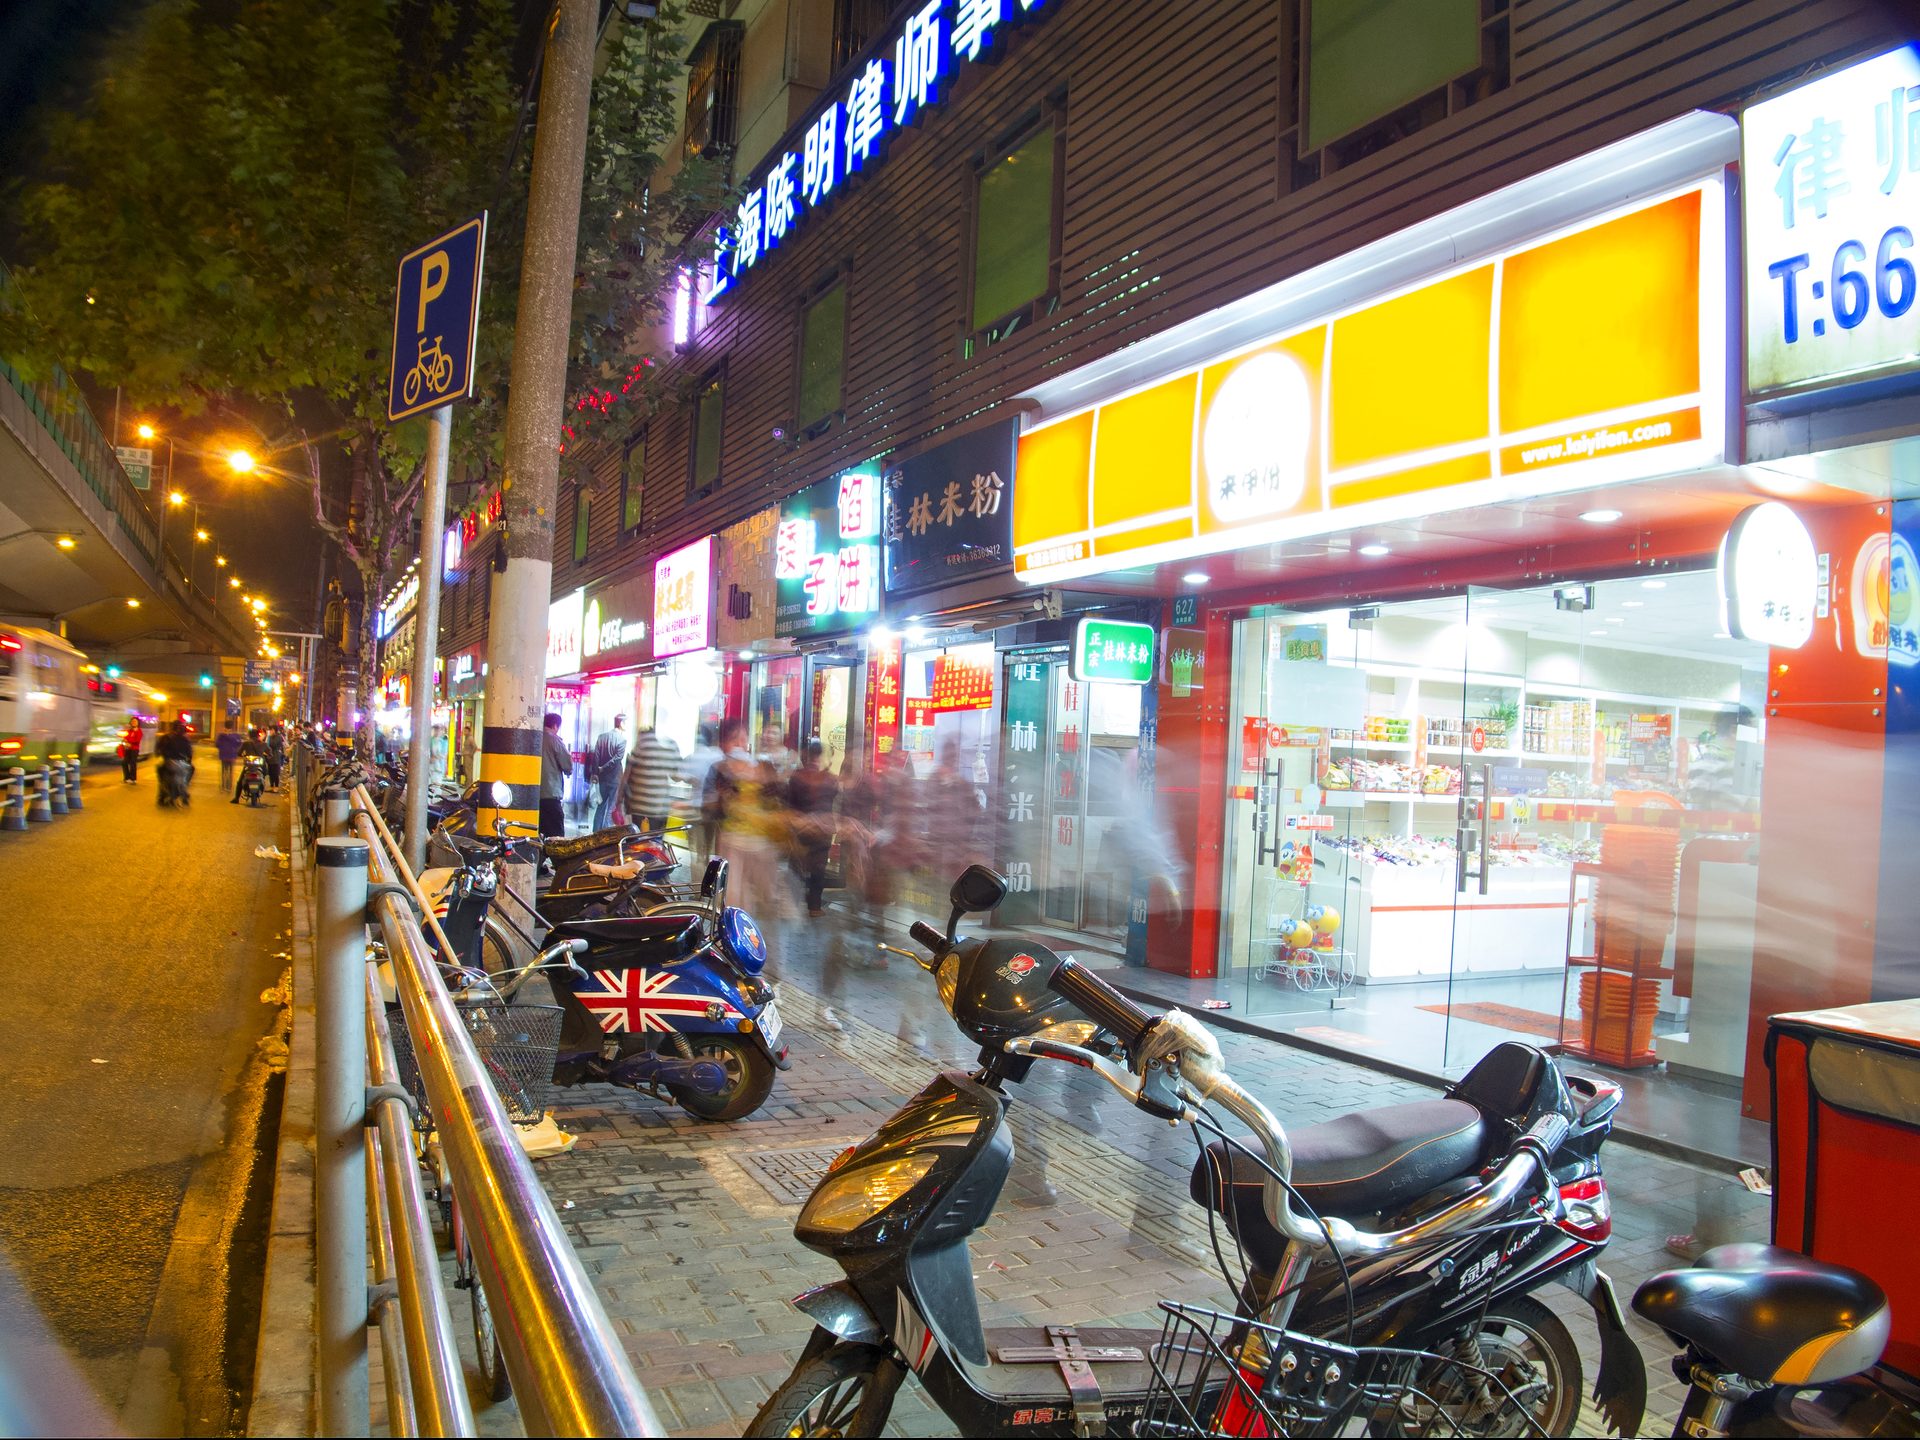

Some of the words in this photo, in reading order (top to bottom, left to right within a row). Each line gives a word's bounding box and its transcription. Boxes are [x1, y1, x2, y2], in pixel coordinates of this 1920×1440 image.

[704, 0, 1036, 305] 上海陈明律师事
[417, 250, 450, 334] P
[1521, 420, 1671, 464] www.laiyifen.com
[1175, 599, 1194, 615] 627
[1088, 632, 1102, 668] 正宗
[1103, 640, 1150, 664] 桂林米粉
[1012, 1407, 1054, 1425] 绿亮
